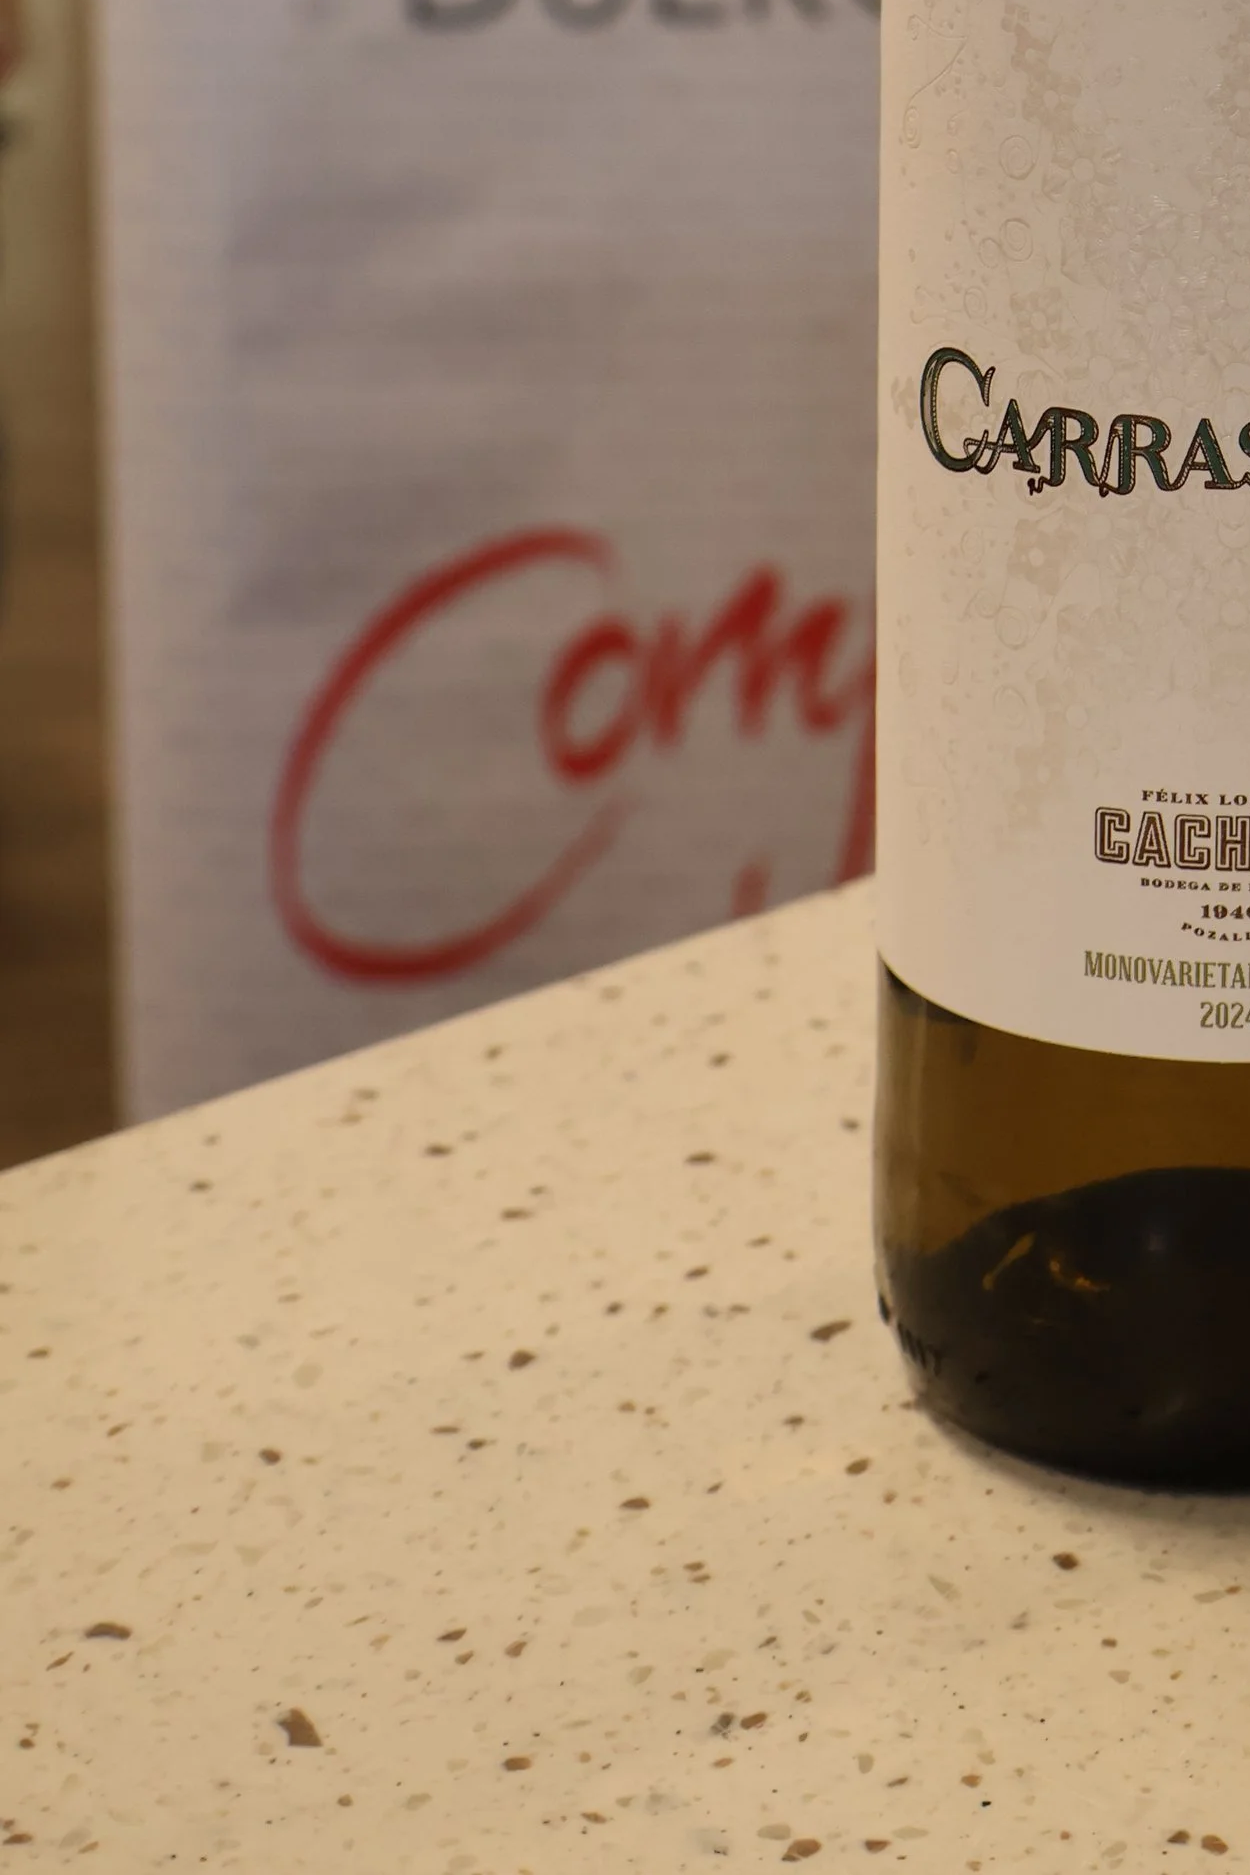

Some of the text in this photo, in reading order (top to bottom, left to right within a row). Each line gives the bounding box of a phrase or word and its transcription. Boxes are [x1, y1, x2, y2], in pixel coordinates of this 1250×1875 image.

[1141, 787, 1210, 806] FÉLIX
[1139, 877, 1212, 892] BODEGA
[1218, 881, 1242, 892] DE
